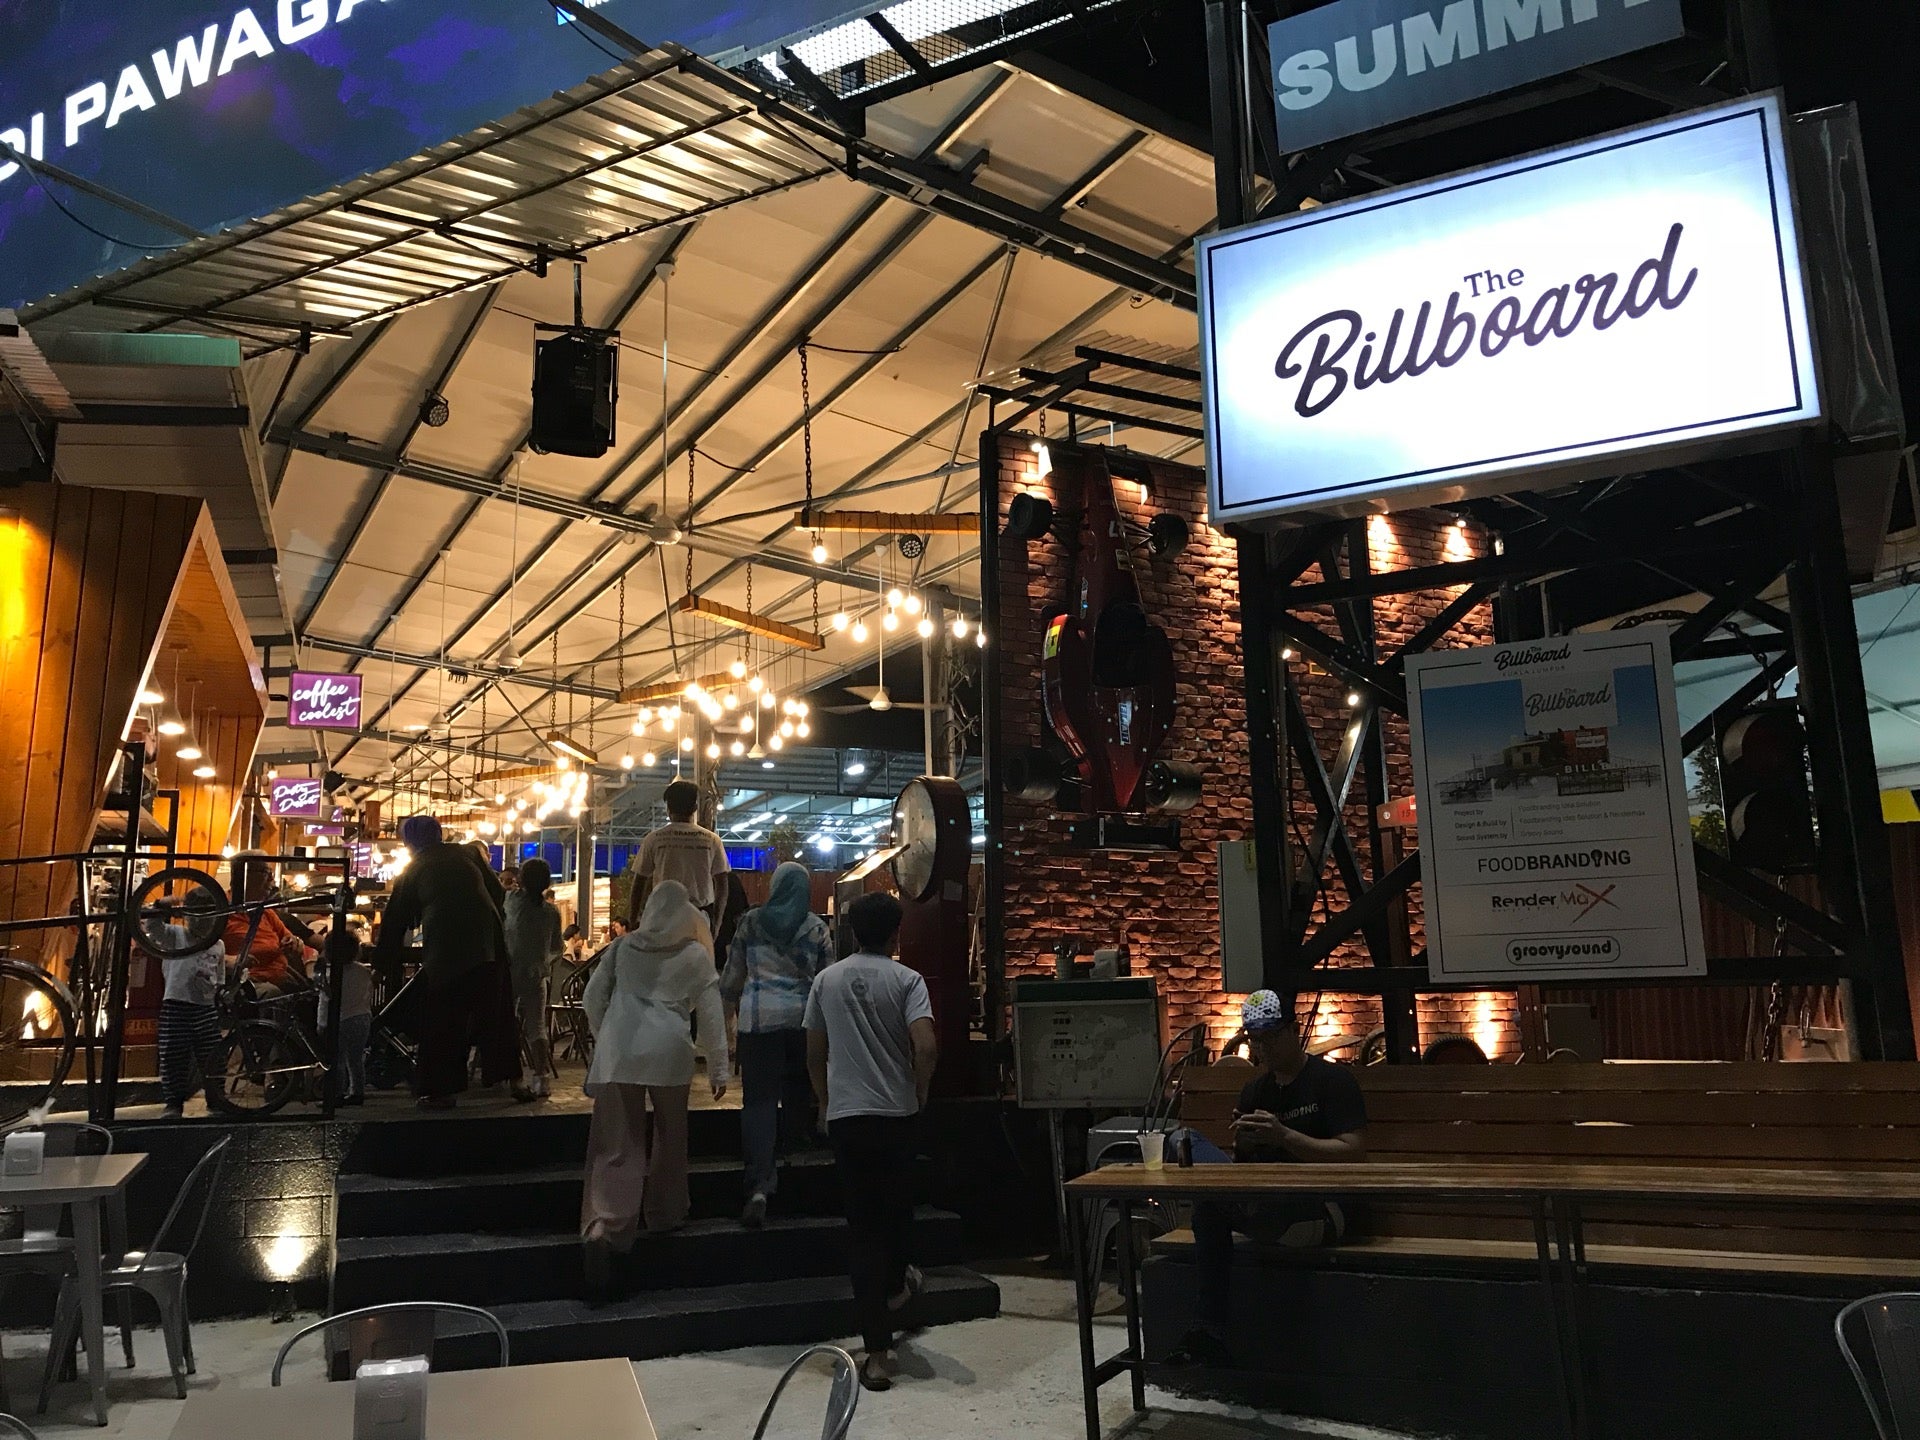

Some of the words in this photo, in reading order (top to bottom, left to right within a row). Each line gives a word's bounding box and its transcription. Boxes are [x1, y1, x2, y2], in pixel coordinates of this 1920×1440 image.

[1277, 0, 1650, 112] SUMM
[1463, 265, 1525, 299] The
[1275, 222, 1698, 417] Billboard
[1494, 642, 1571, 671] Billboard
[292, 678, 349, 709] coffee
[298, 696, 361, 721] coolest
[1525, 682, 1612, 716] Billboard
[1491, 893, 1557, 909] Render
[1512, 940, 1612, 961] groovysound
